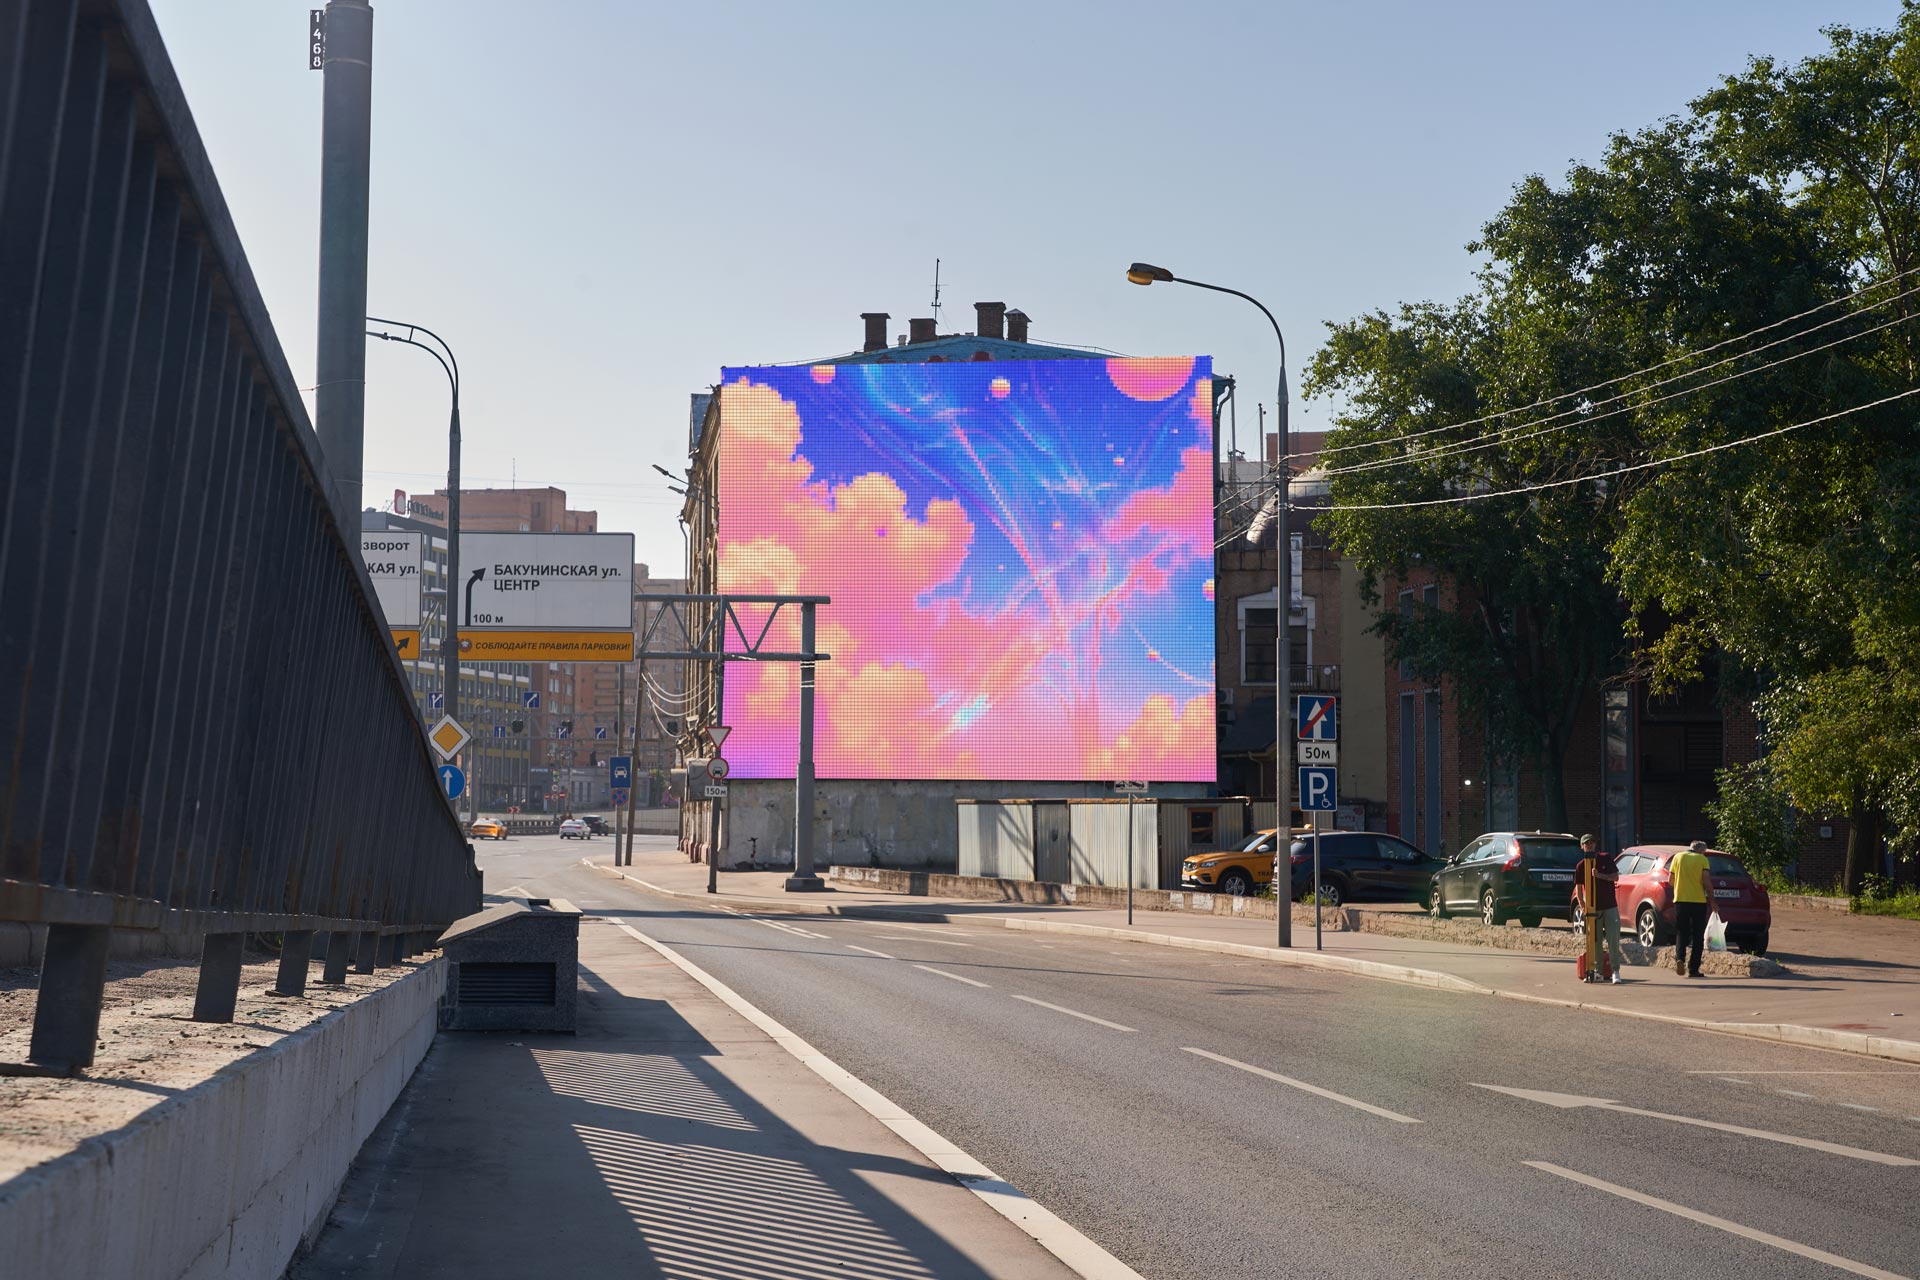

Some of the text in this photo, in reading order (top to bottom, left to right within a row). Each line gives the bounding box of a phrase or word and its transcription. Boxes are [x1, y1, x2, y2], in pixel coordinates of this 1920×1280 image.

[313, 11, 322, 67] 1468
[362, 541, 410, 553] зворот
[399, 566, 419, 577] ул.
[494, 564, 621, 579] БАКУНИНСКАЯ ул.
[494, 579, 540, 592] ЦЕНТР
[473, 614, 492, 623] 100
[475, 641, 631, 651] СОБЛЮДАЙТЕ ПРАВИЛА ПАРКОВКИ!
